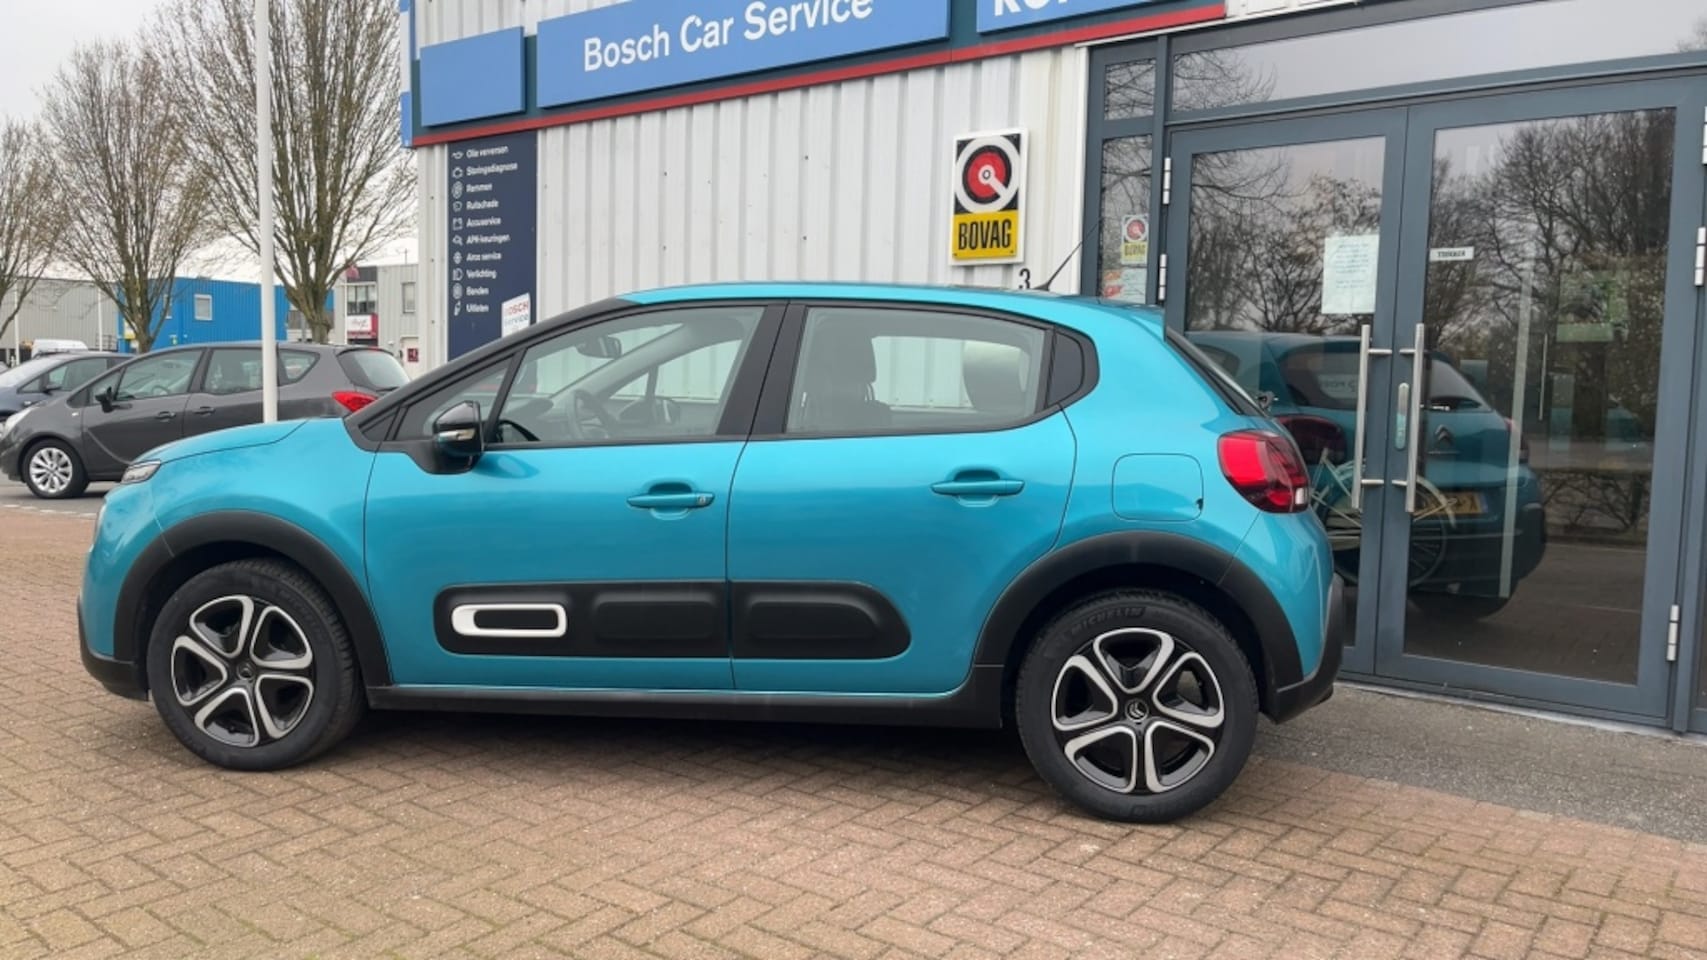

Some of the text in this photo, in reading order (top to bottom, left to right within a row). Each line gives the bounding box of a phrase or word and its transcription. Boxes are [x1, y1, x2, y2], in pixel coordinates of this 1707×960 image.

[584, 0, 873, 72] Bosch Car Service
[958, 218, 1012, 251] BOVAG
[1018, 268, 1031, 289] 3
